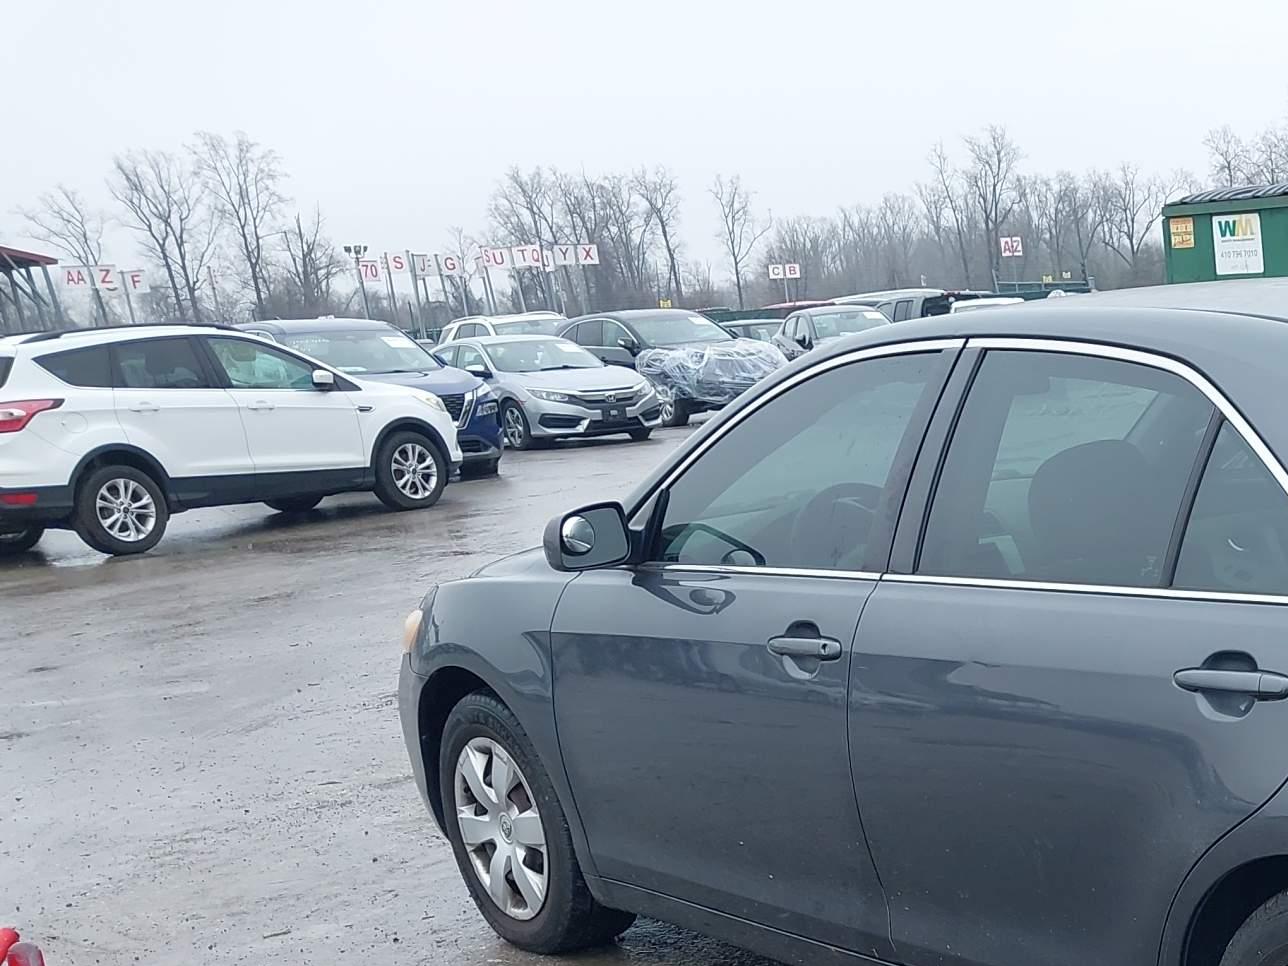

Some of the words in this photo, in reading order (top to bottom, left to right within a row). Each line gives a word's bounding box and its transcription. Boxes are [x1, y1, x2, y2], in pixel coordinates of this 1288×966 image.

[1218, 216, 1255, 238] WM
[492, 251, 505, 265] U
[517, 249, 527, 262] T
[559, 247, 569, 261] Y
[582, 247, 593, 260] X
[393, 256, 404, 270] S
[444, 257, 456, 271] G
[67, 269, 87, 285] AA
[99, 269, 114, 284] Z
[361, 264, 378, 278] 70
[772, 266, 780, 276] C
[131, 274, 141, 289] F
